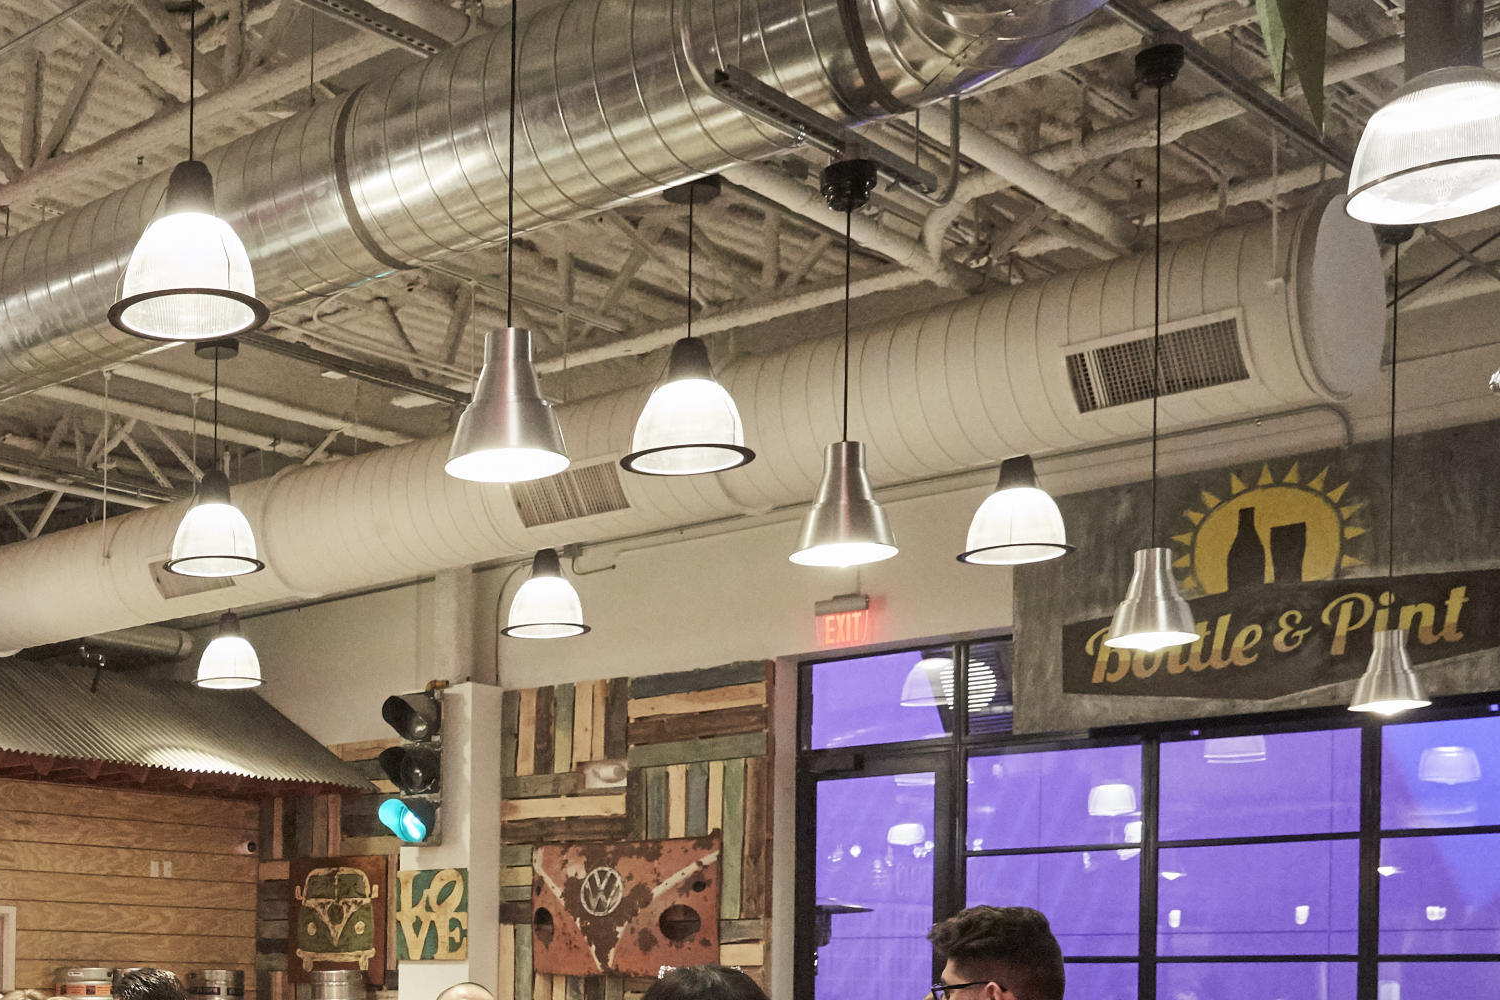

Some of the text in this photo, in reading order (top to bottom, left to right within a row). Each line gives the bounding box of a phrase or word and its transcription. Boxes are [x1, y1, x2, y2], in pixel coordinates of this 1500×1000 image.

[825, 612, 862, 645] EXIT
[1273, 609, 1312, 653] &
[1320, 586, 1469, 656] Pint
